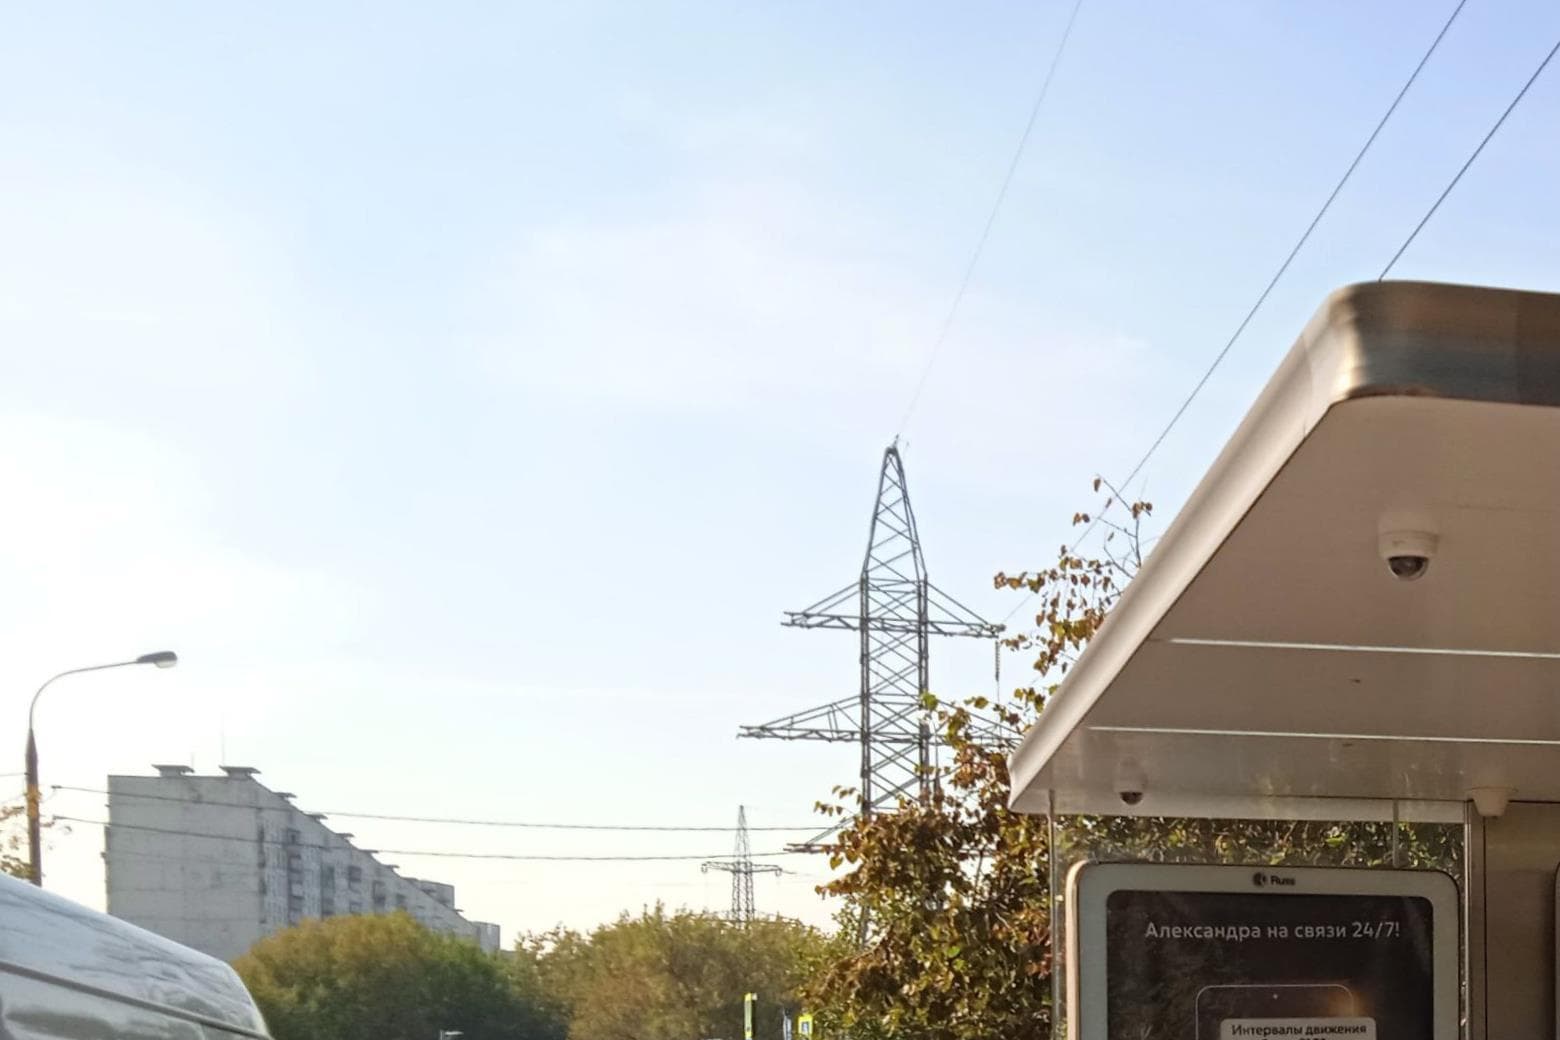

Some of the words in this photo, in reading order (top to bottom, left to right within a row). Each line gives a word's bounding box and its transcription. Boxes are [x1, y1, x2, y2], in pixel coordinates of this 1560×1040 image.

[1144, 922, 1262, 941] Александра
[1267, 924, 1289, 938] на
[1294, 922, 1347, 938] связи
[1352, 921, 1401, 938] 24/7!
[1232, 1024, 1303, 1037] Интервалы
[1305, 1025, 1367, 1036] движения
